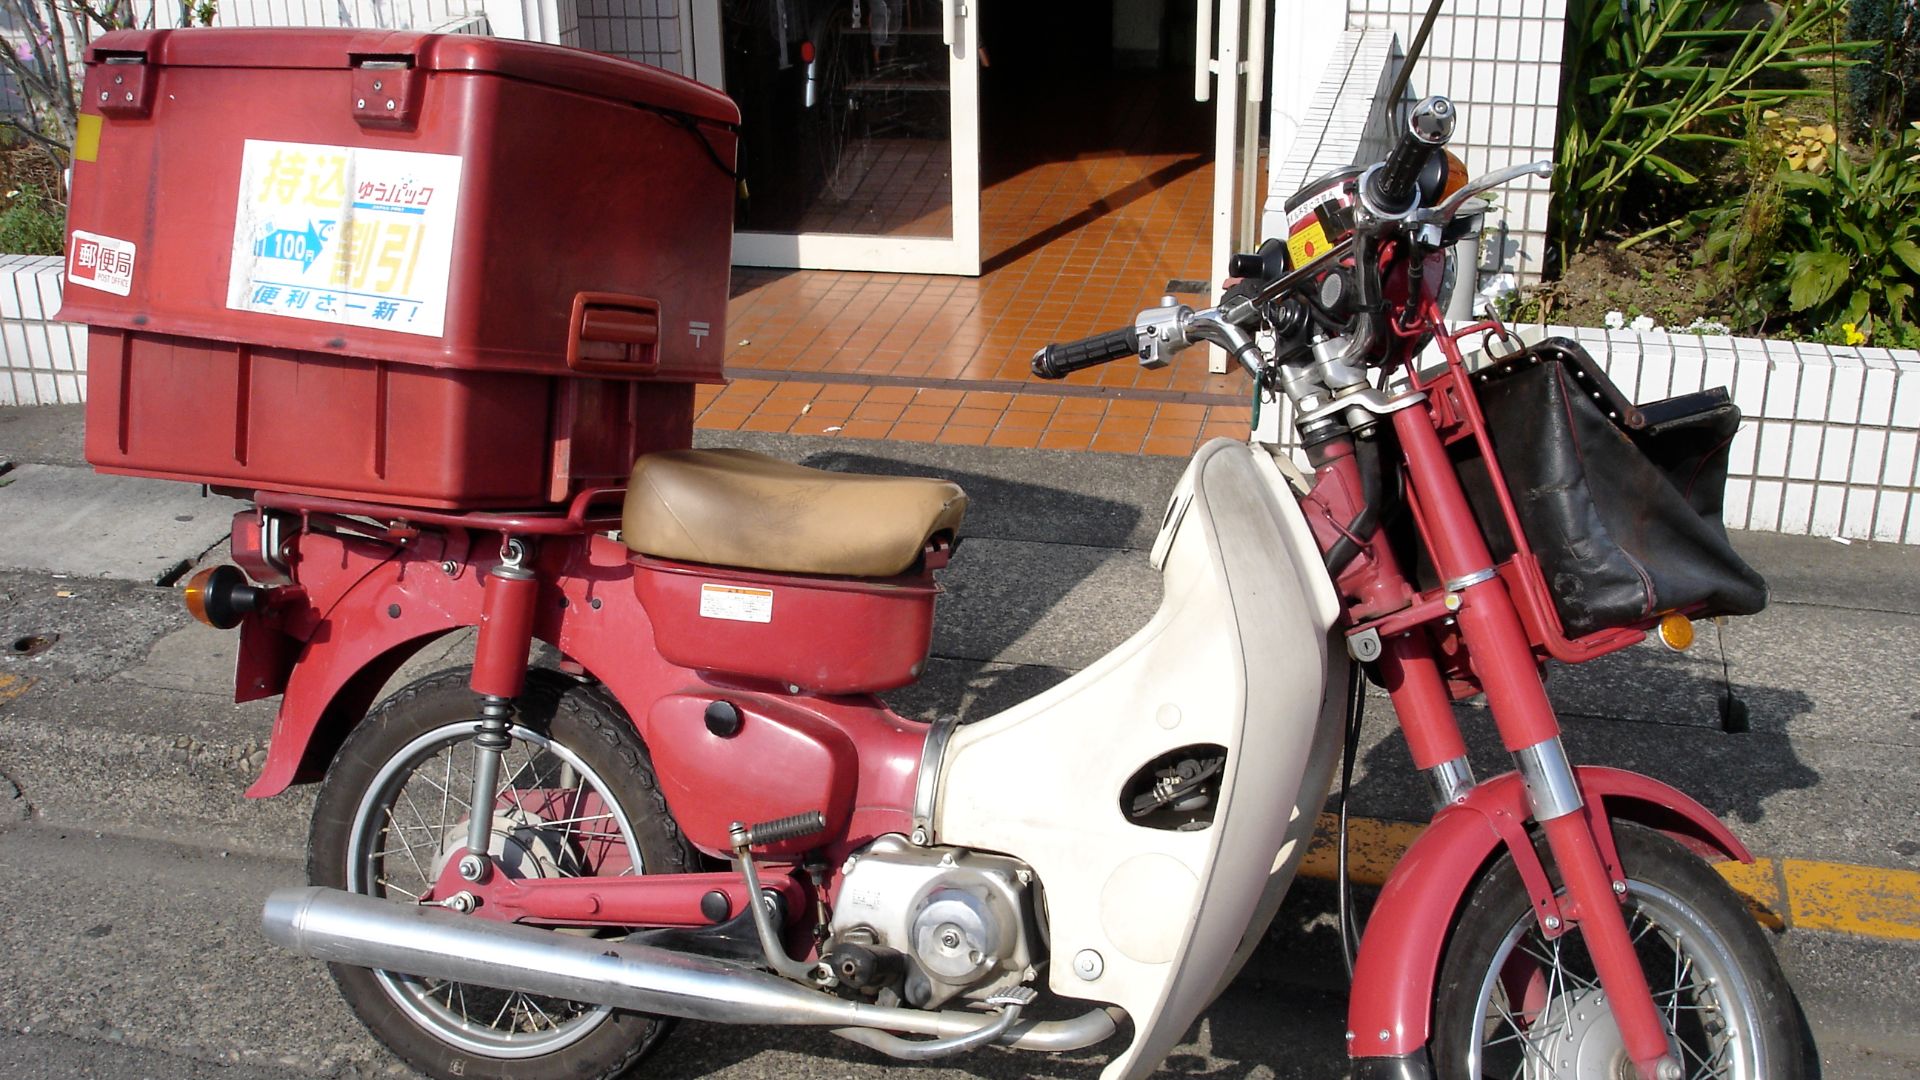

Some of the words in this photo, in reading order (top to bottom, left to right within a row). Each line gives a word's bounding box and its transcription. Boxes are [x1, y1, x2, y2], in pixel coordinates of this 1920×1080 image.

[259, 150, 346, 208] 持込
[358, 180, 434, 206] ゆうパック
[78, 242, 132, 278] 郵便局
[329, 218, 426, 295] 割引
[97, 272, 111, 284] POST
[111, 275, 129, 289] OFFICE
